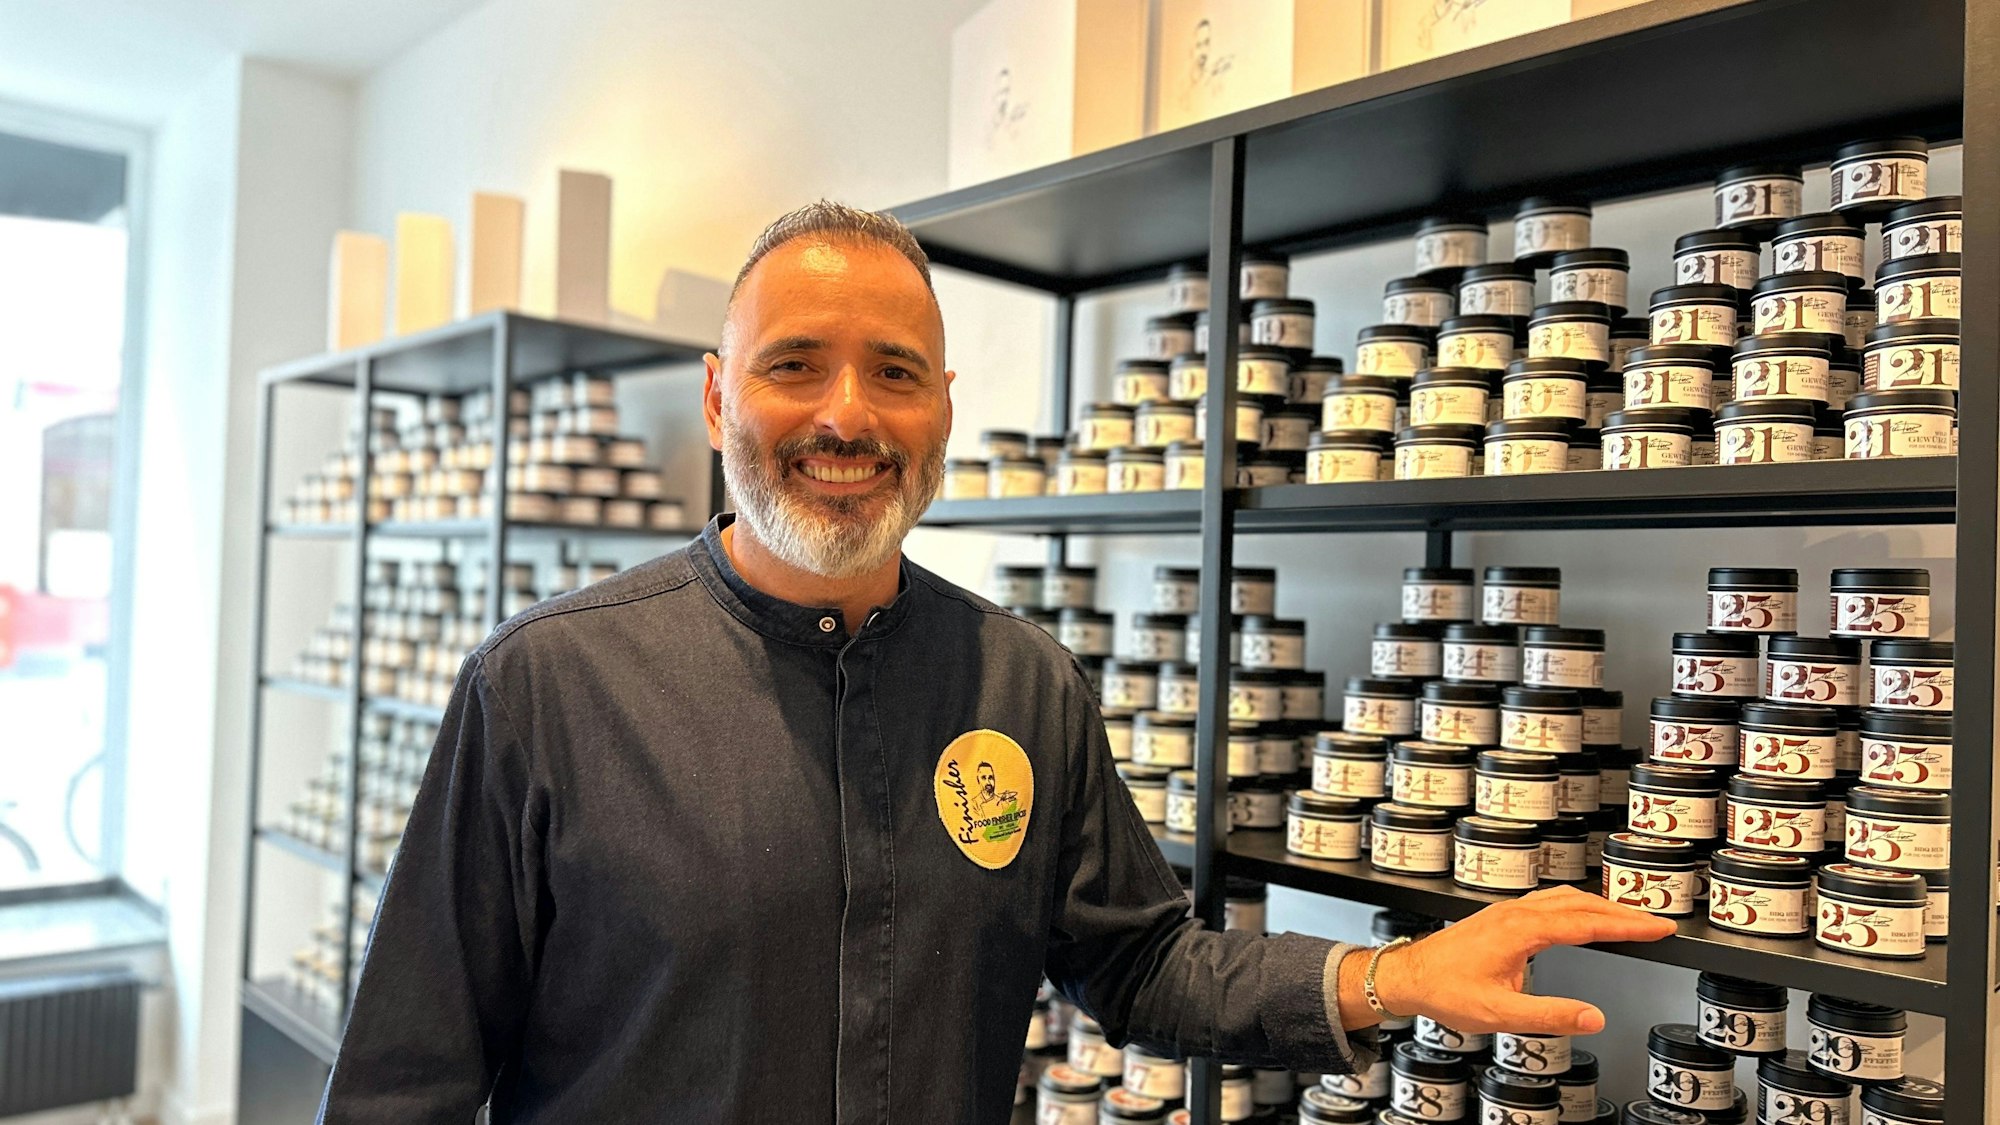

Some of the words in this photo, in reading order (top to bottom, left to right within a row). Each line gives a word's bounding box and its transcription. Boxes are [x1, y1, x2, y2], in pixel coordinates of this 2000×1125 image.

[1850, 162, 1907, 198] 21
[1728, 184, 1773, 219] 21
[1781, 240, 1824, 273] 21
[1899, 224, 1948, 254] 21
[1681, 253, 1721, 284] 21
[1760, 295, 1814, 334] 21
[1884, 281, 1943, 323] 21
[1659, 308, 1708, 344] 21
[1743, 360, 1797, 397] 21
[1889, 347, 1952, 387] 21
[1630, 370, 1680, 406] 21
[1727, 427, 1777, 465] 21
[1849, 418, 1903, 459] 21
[1718, 594, 1773, 628] 25
[1845, 596, 1906, 633] 25
[1675, 658, 1726, 692] 25
[1779, 664, 1838, 701] 25
[1875, 669, 1943, 707] 25
[1661, 725, 1714, 761] 25
[1752, 735, 1811, 774] 25
[1868, 743, 1929, 784] 25
[942, 759, 979, 844] Finisher
[1631, 794, 1678, 833] 25
[973, 819, 991, 828] FOOD
[1743, 808, 1803, 848] 25
[1848, 819, 1902, 862] 25
[1616, 870, 1672, 910] 25
[1711, 882, 1757, 926] 25
[1820, 901, 1879, 948] 25
[1704, 1007, 1756, 1047] 29
[1501, 1035, 1548, 1072] 28
[1810, 1027, 1862, 1072] 29
[1400, 1081, 1443, 1118] 28
[1653, 1063, 1701, 1105] 29
[1773, 1093, 1832, 1125] 29
